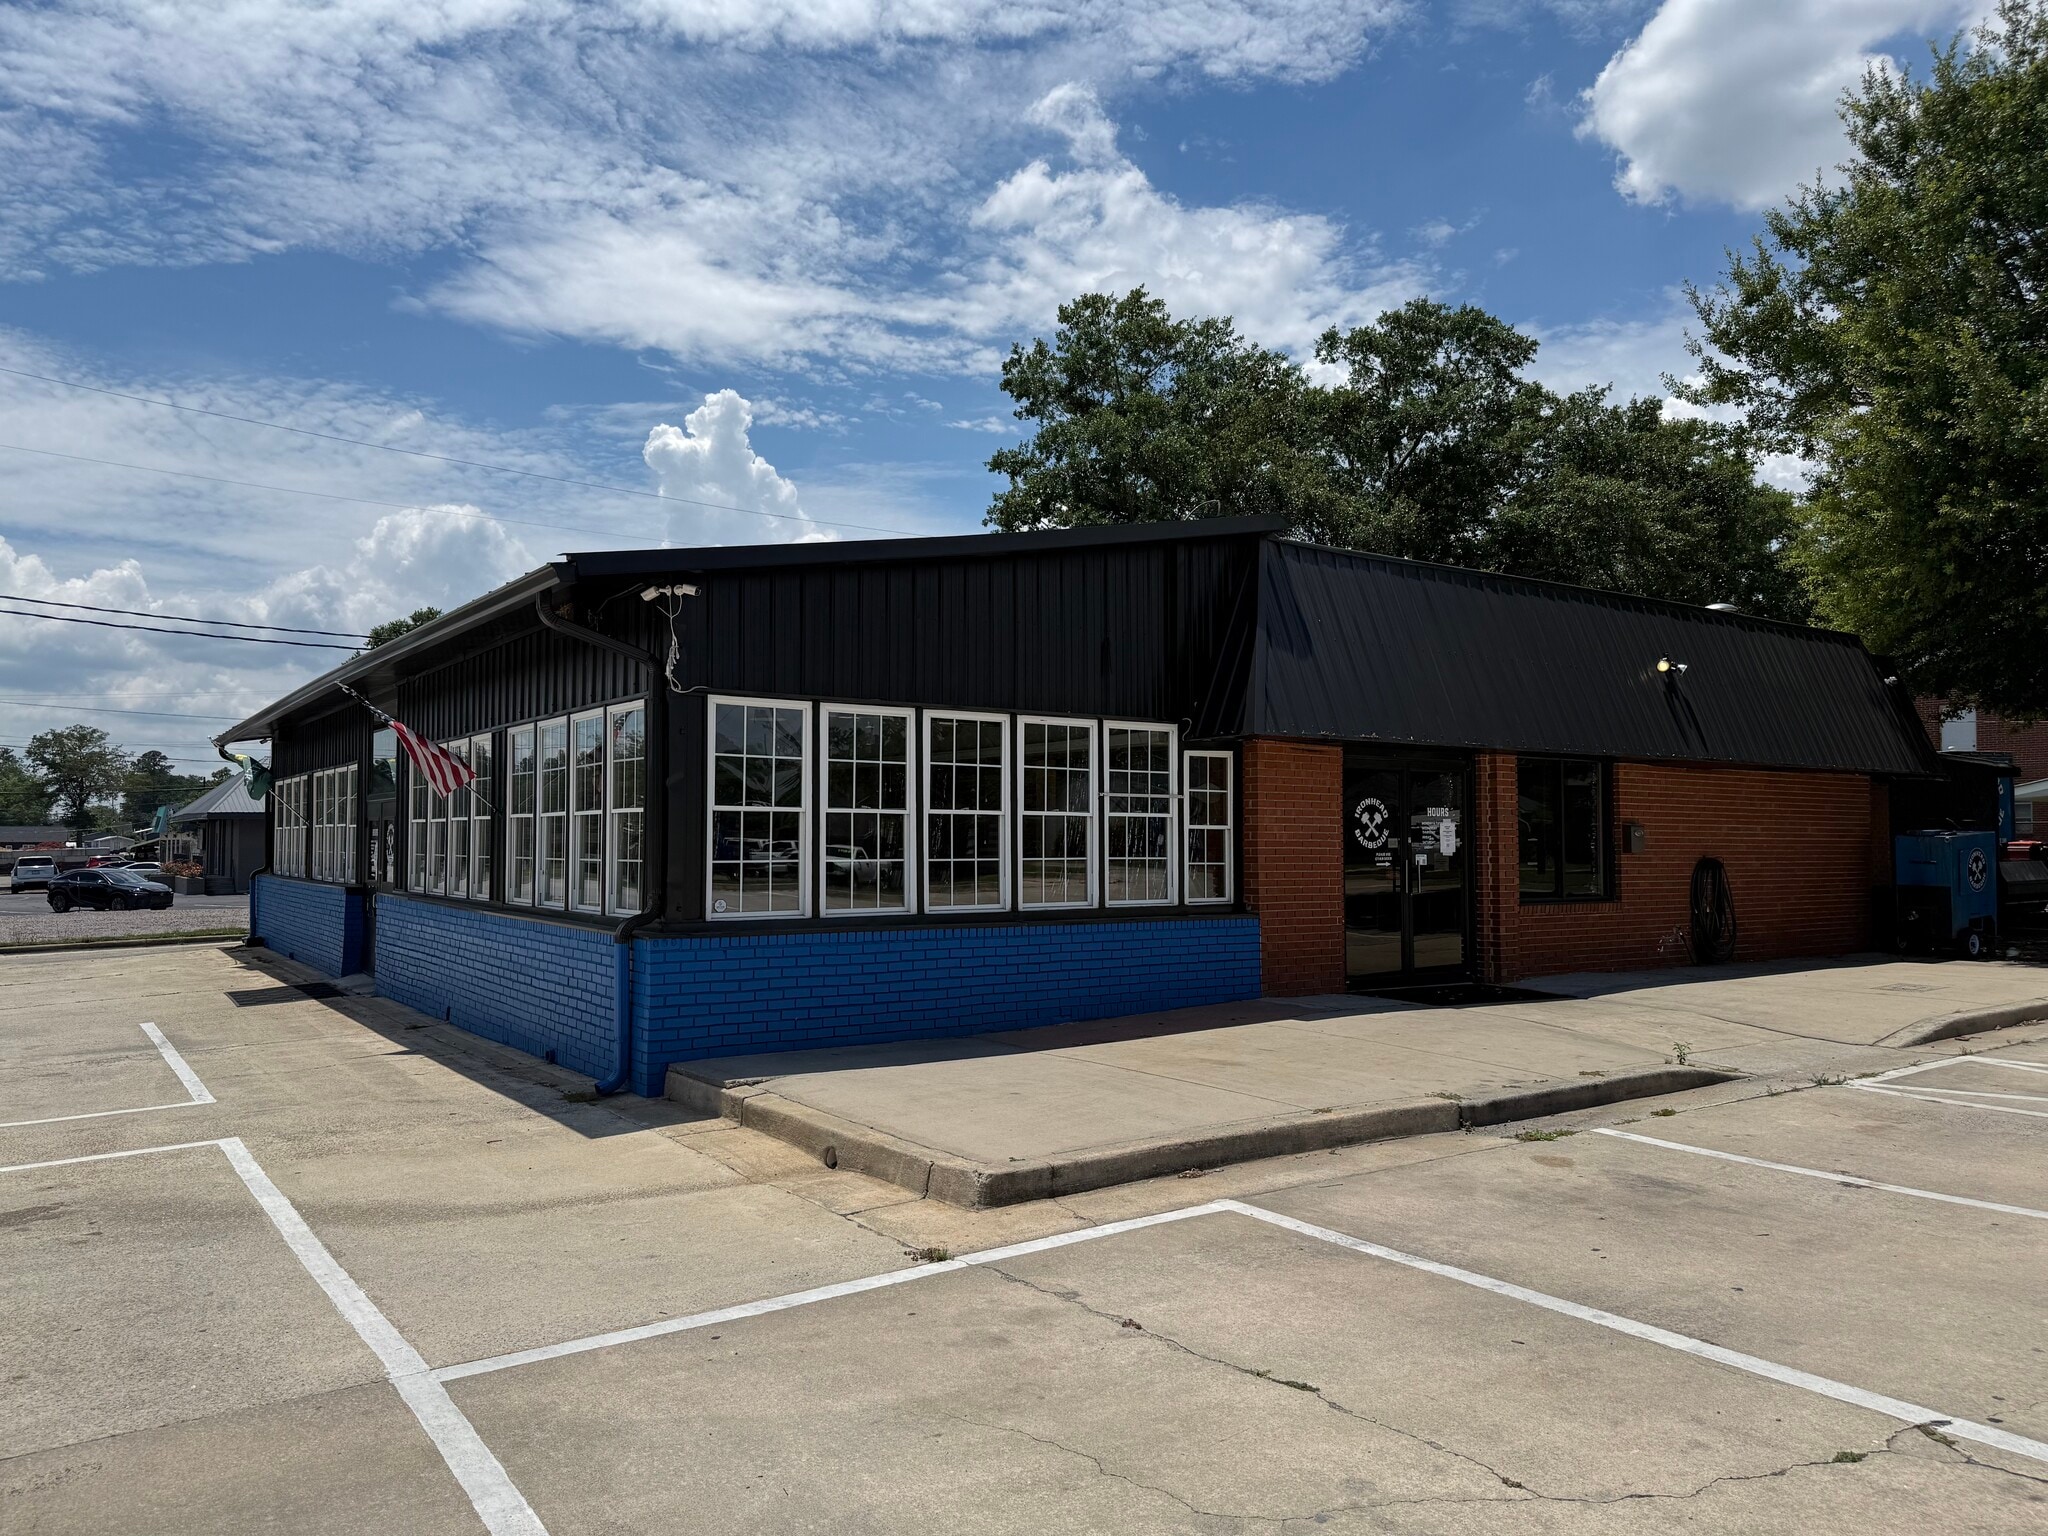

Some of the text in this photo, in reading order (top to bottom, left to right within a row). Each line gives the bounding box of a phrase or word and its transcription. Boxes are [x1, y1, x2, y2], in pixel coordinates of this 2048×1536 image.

[1354, 797, 1389, 818] IRONHEAD
[1427, 807, 1449, 816] HOURS
[1354, 828, 1390, 849] BARBEQUE
